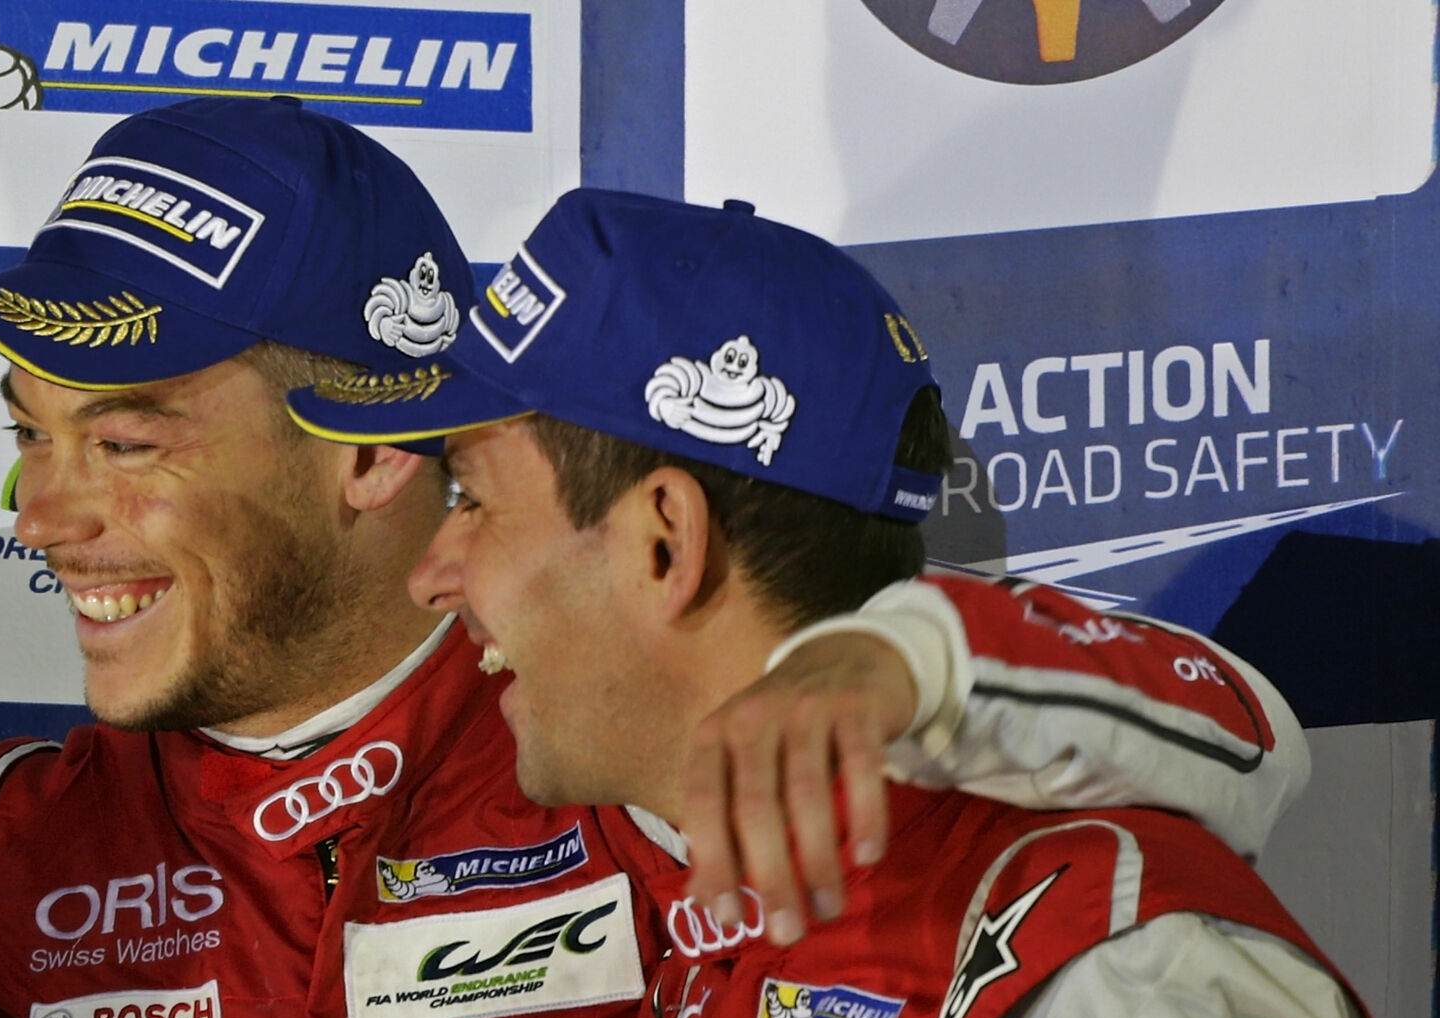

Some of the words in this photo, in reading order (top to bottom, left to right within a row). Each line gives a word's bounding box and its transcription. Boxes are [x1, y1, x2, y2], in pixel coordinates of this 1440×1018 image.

[45, 22, 517, 91] MICHELIN
[68, 175, 242, 250] MICHELIN
[959, 338, 1272, 439] ACTION
[942, 444, 1122, 517] ROAD
[1143, 418, 1404, 499] SAFETY
[454, 834, 581, 879] MICHELIN
[35, 862, 225, 941] ORIS
[29, 941, 105, 974] Swiss
[116, 929, 221, 966] Watches
[417, 900, 618, 983] WEC
[366, 993, 392, 1007] FIA
[395, 986, 449, 1004] WORLD
[450, 966, 549, 994] ENDURANCE
[429, 980, 544, 1010] CHAMPIONSHIP
